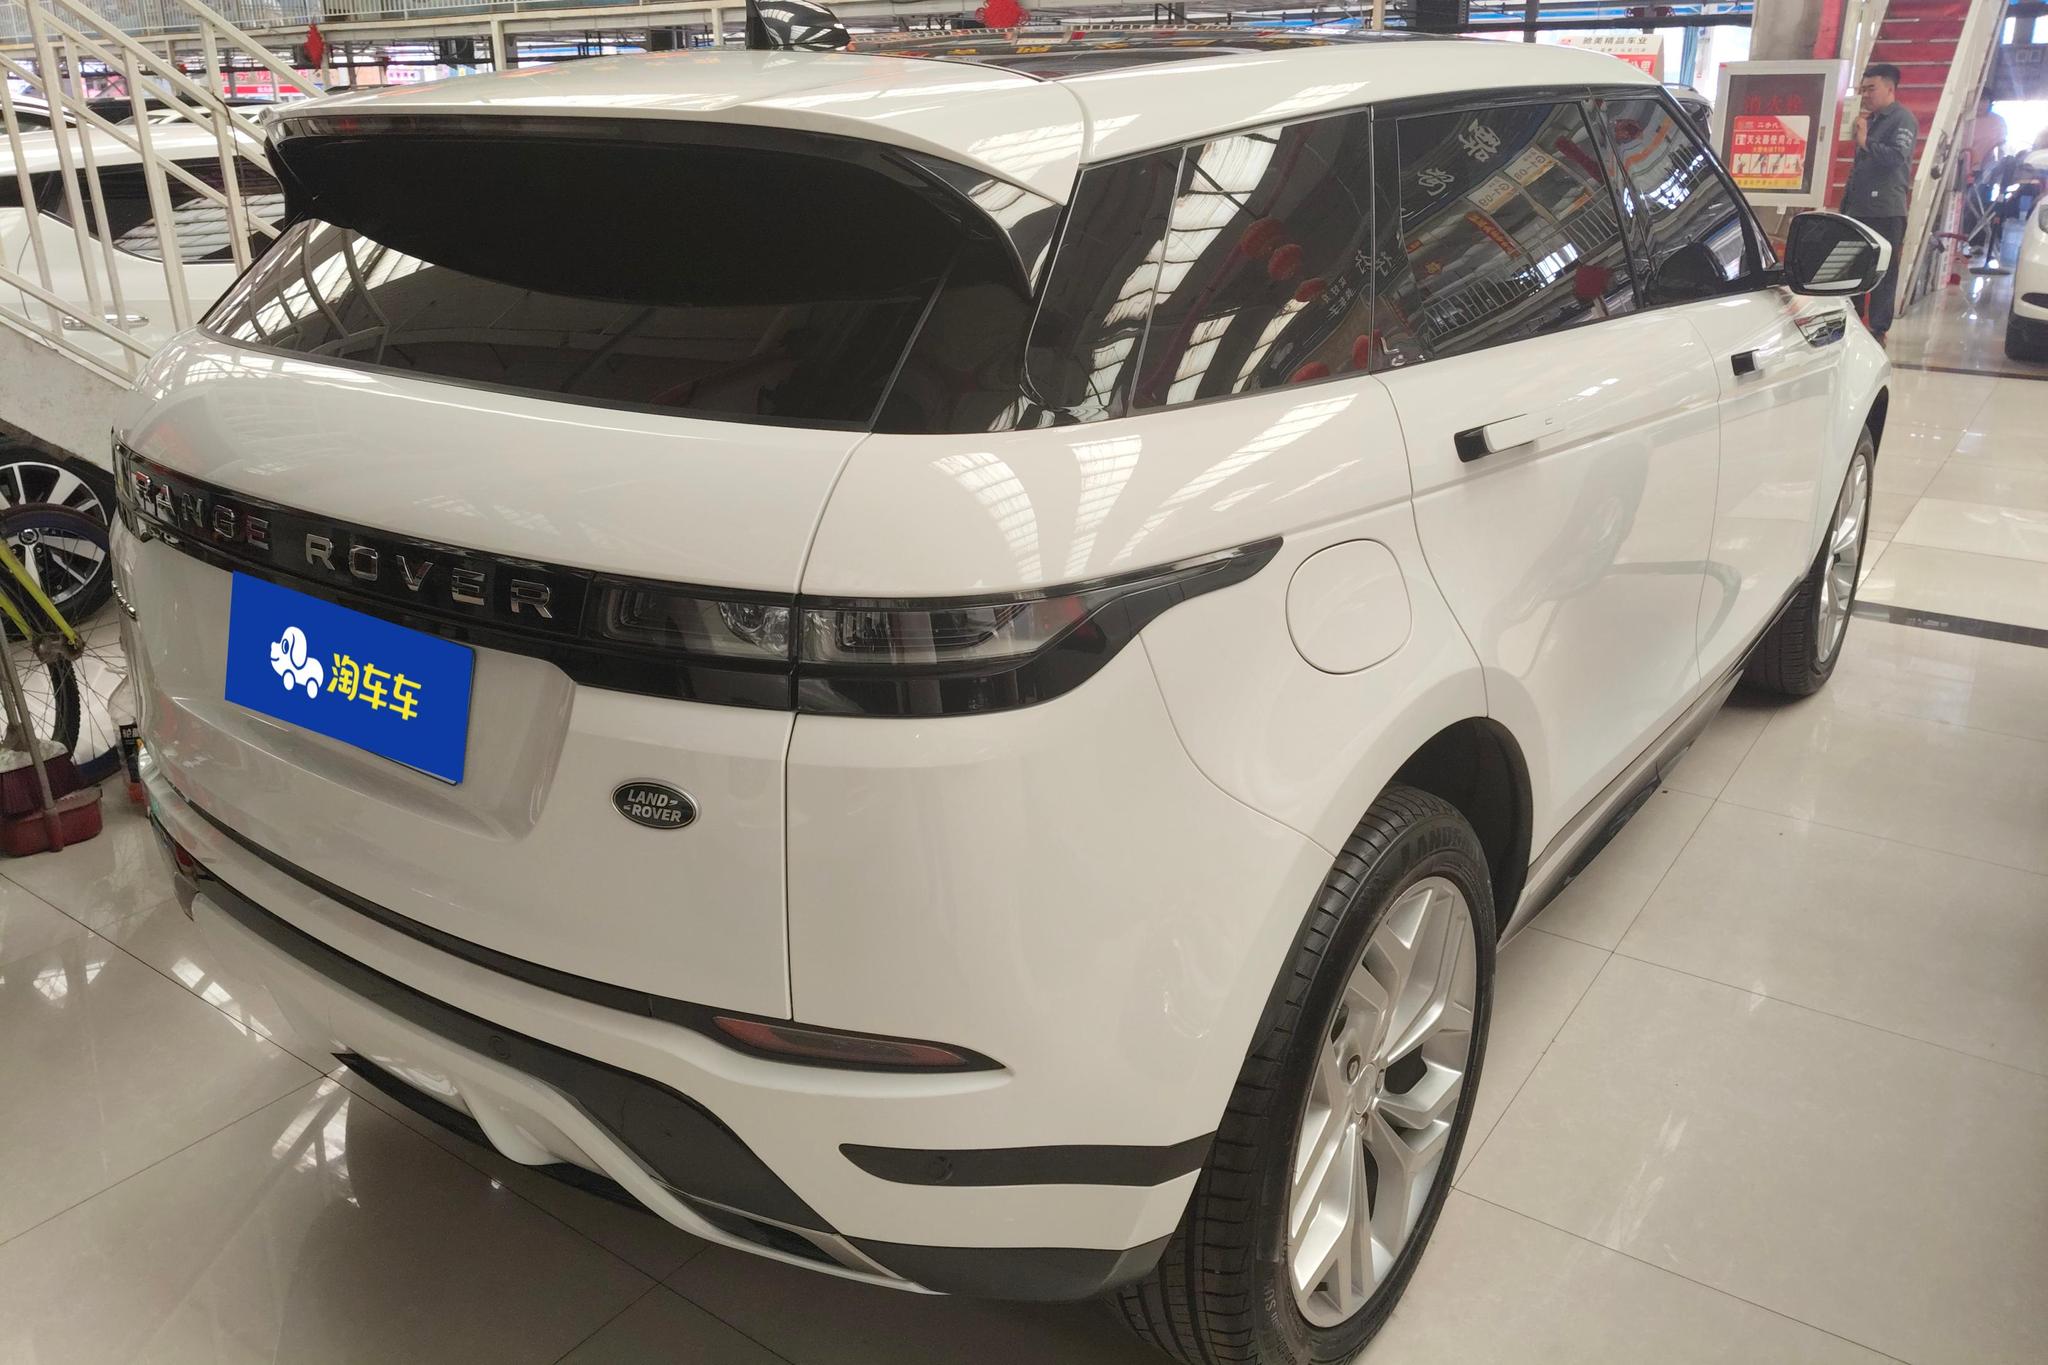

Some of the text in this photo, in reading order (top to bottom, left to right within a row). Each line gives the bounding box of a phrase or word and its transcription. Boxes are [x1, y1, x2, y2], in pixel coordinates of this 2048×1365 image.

[135, 470, 554, 619] RANGE ROVER
[627, 789, 669, 807] LAND
[631, 803, 682, 823] ROVER
